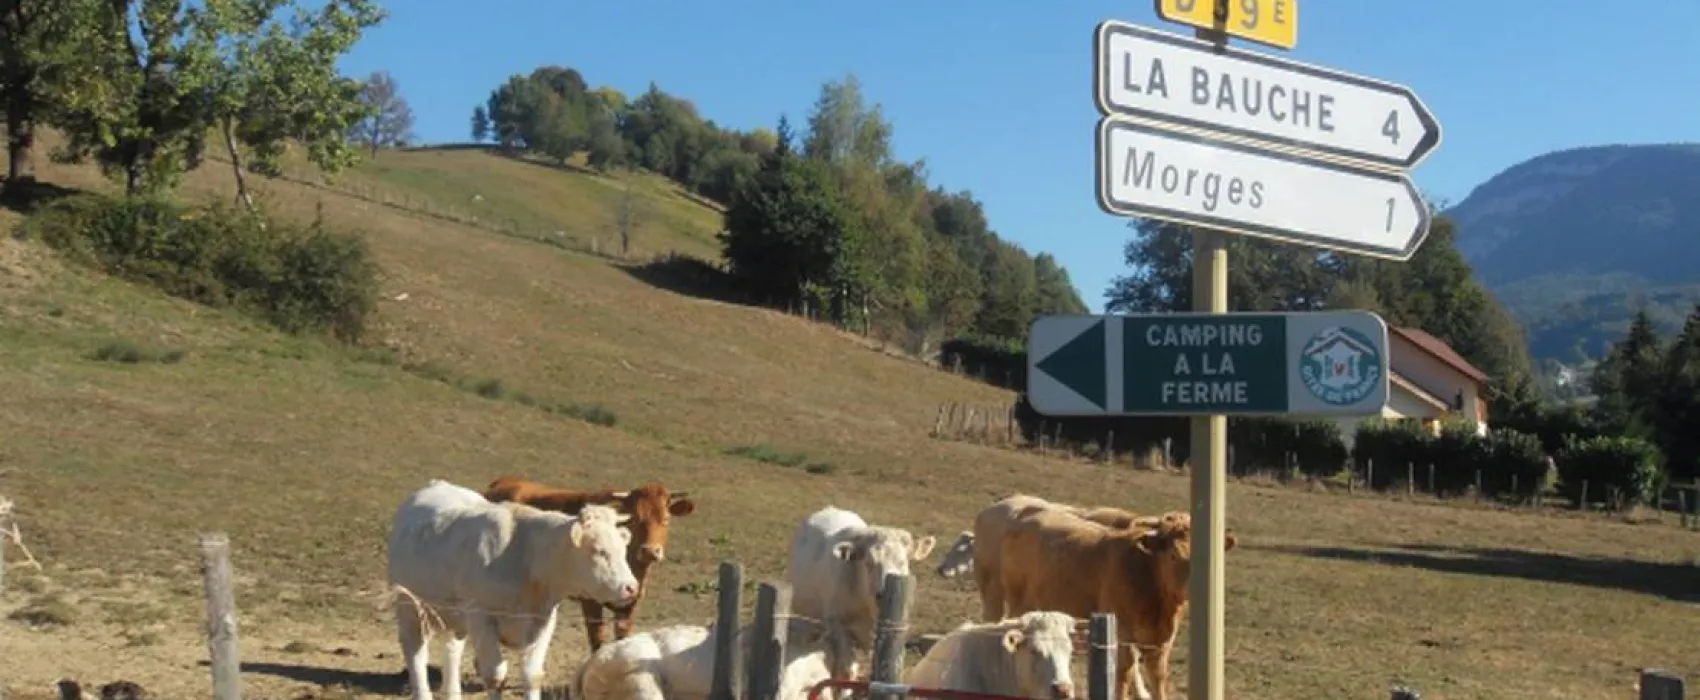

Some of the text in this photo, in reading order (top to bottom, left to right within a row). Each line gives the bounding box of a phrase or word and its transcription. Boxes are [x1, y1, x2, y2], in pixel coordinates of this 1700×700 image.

[1123, 52, 1400, 144] LA BAUCHE 4
[1123, 147, 1395, 232] Morges 1
[1146, 324, 1262, 346] CAMPING
[1174, 353, 1235, 374] A LA
[1161, 382, 1248, 403] FERME
